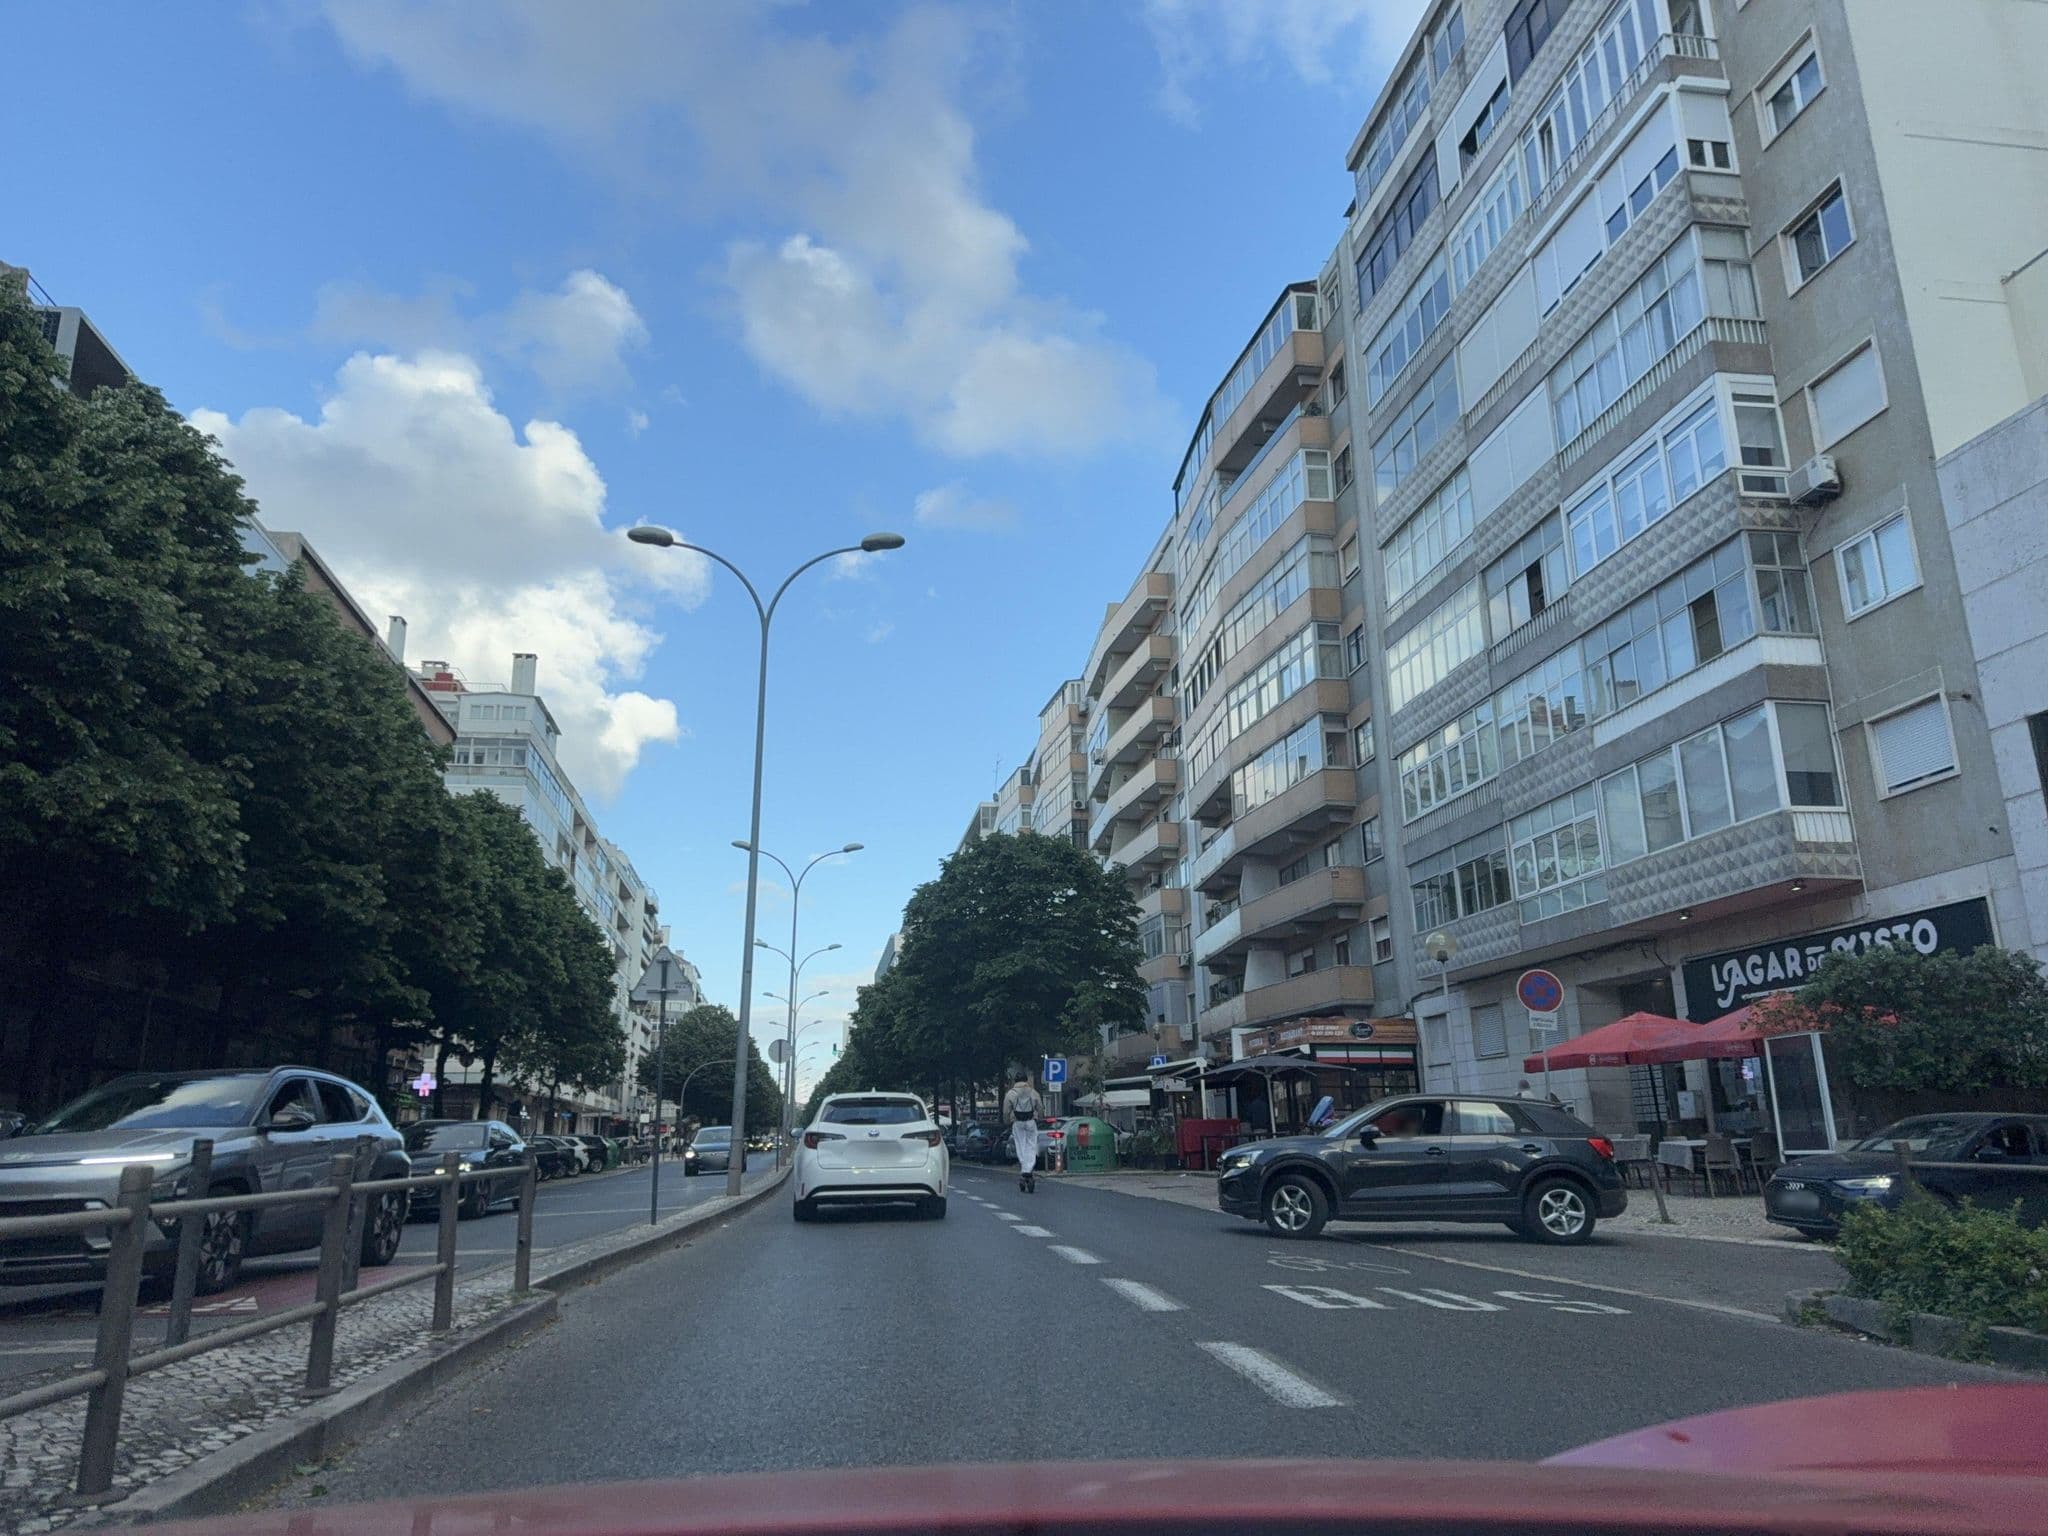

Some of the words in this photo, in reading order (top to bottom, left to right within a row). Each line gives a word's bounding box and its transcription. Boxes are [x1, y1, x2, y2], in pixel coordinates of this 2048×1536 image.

[1711, 947, 1803, 1009] LAGAR
[1049, 1061, 1061, 1080] P
[1261, 1284, 1632, 1315] BUS
